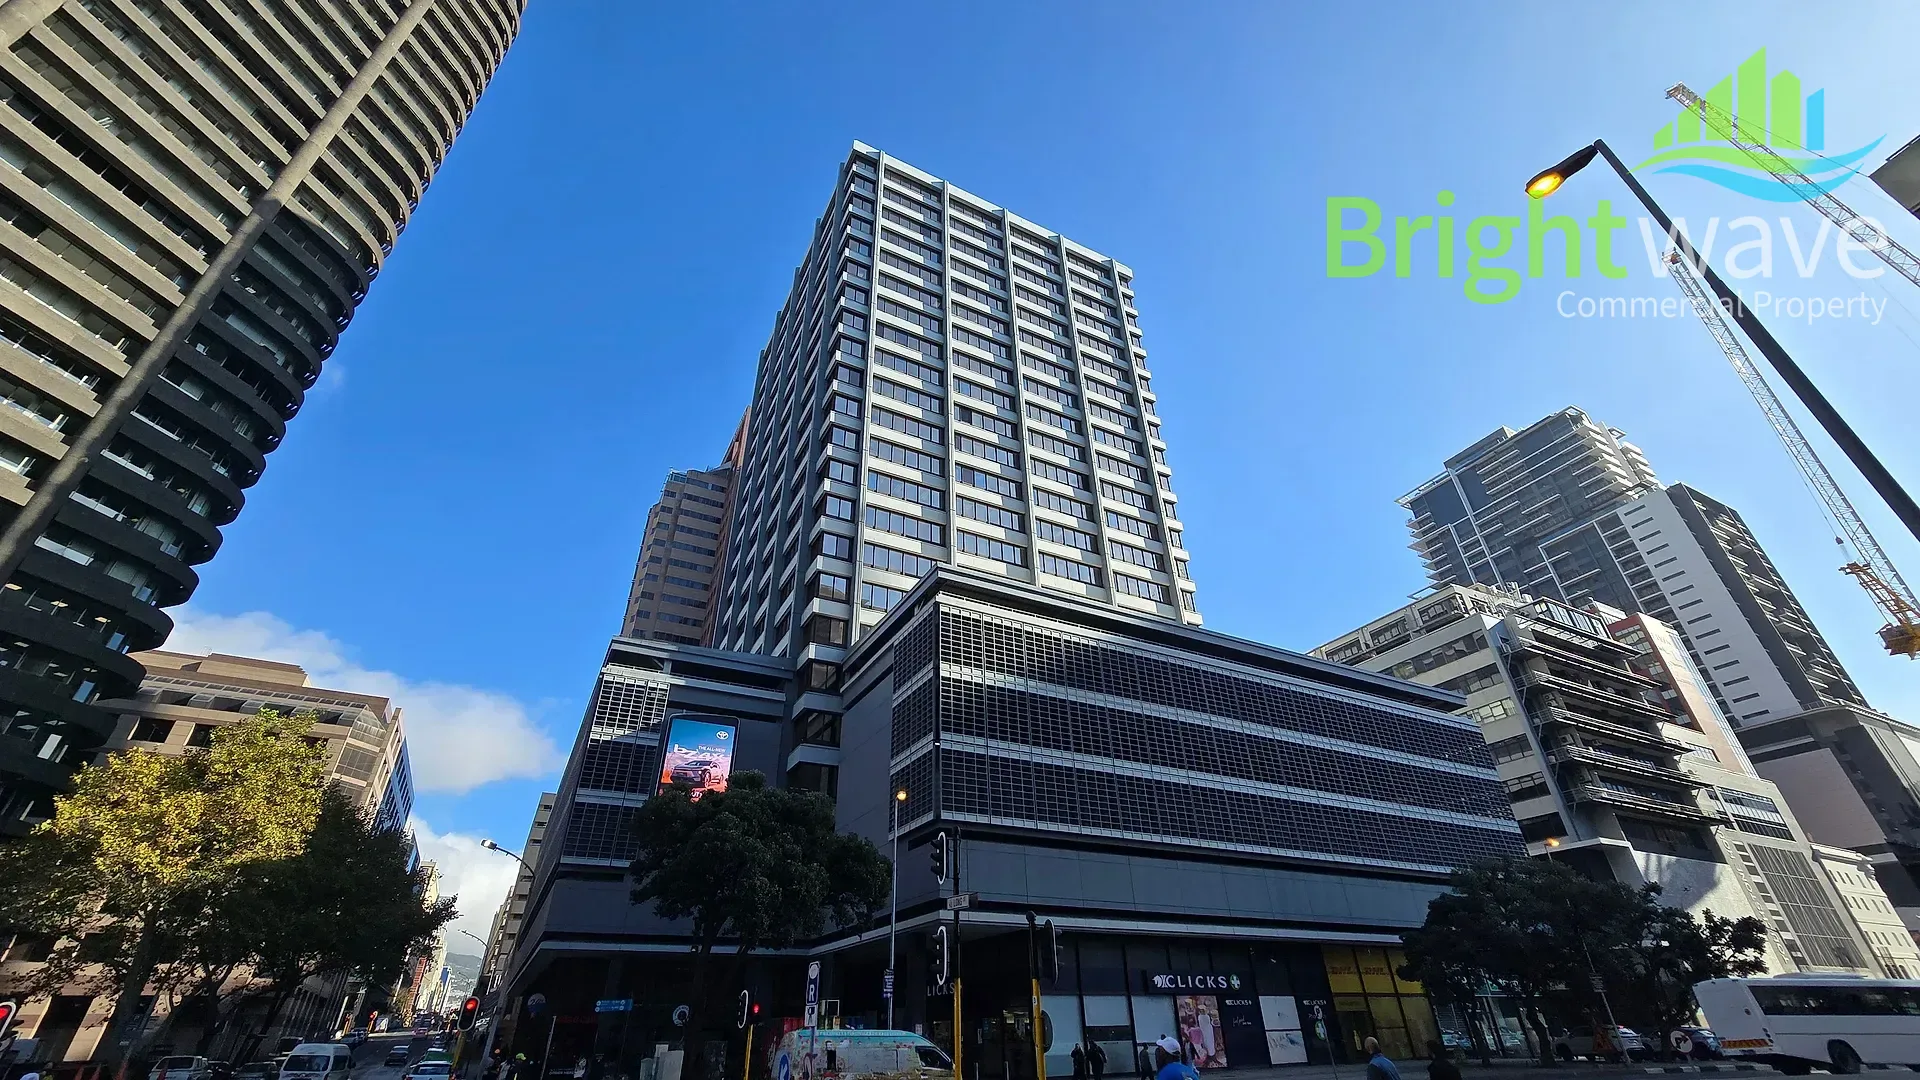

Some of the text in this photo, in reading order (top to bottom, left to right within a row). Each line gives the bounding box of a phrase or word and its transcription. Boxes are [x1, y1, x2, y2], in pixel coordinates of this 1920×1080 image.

[927, 982, 955, 996] LICKS
[1166, 974, 1229, 989] CLICKS
[808, 984, 816, 1002] R
